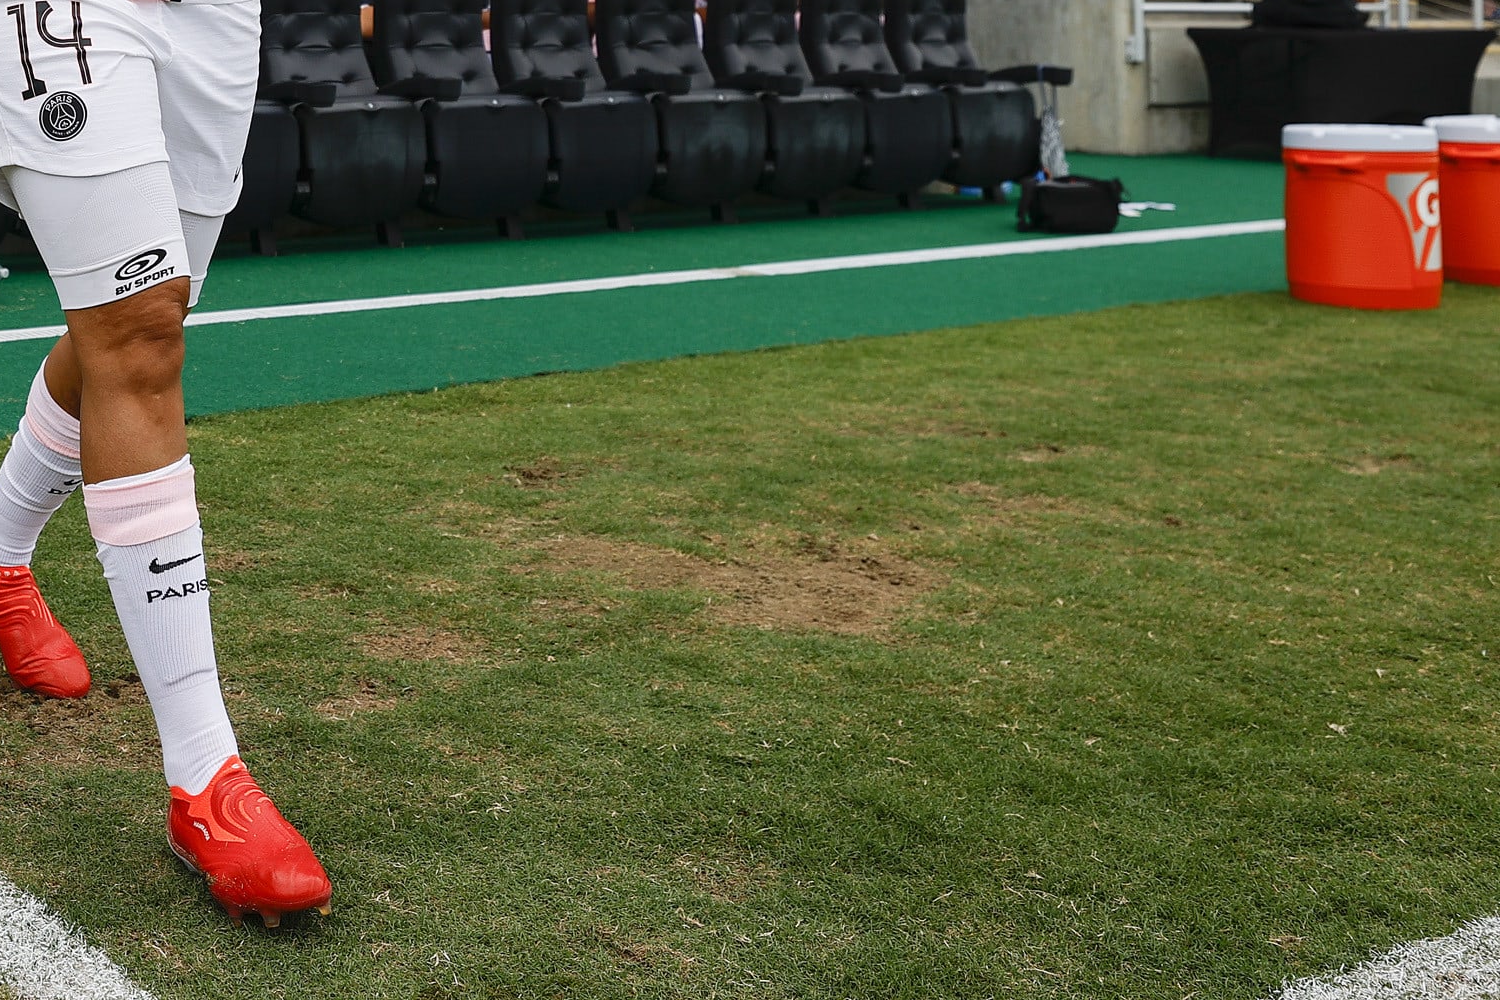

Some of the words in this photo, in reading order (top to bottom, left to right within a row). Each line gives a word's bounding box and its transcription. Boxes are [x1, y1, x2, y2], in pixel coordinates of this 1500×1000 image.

[6, 0, 92, 102] 14
[45, 95, 73, 112] PARIS
[115, 282, 133, 296] BV
[134, 265, 175, 288] SPORT
[146, 577, 209, 603] PARIS
